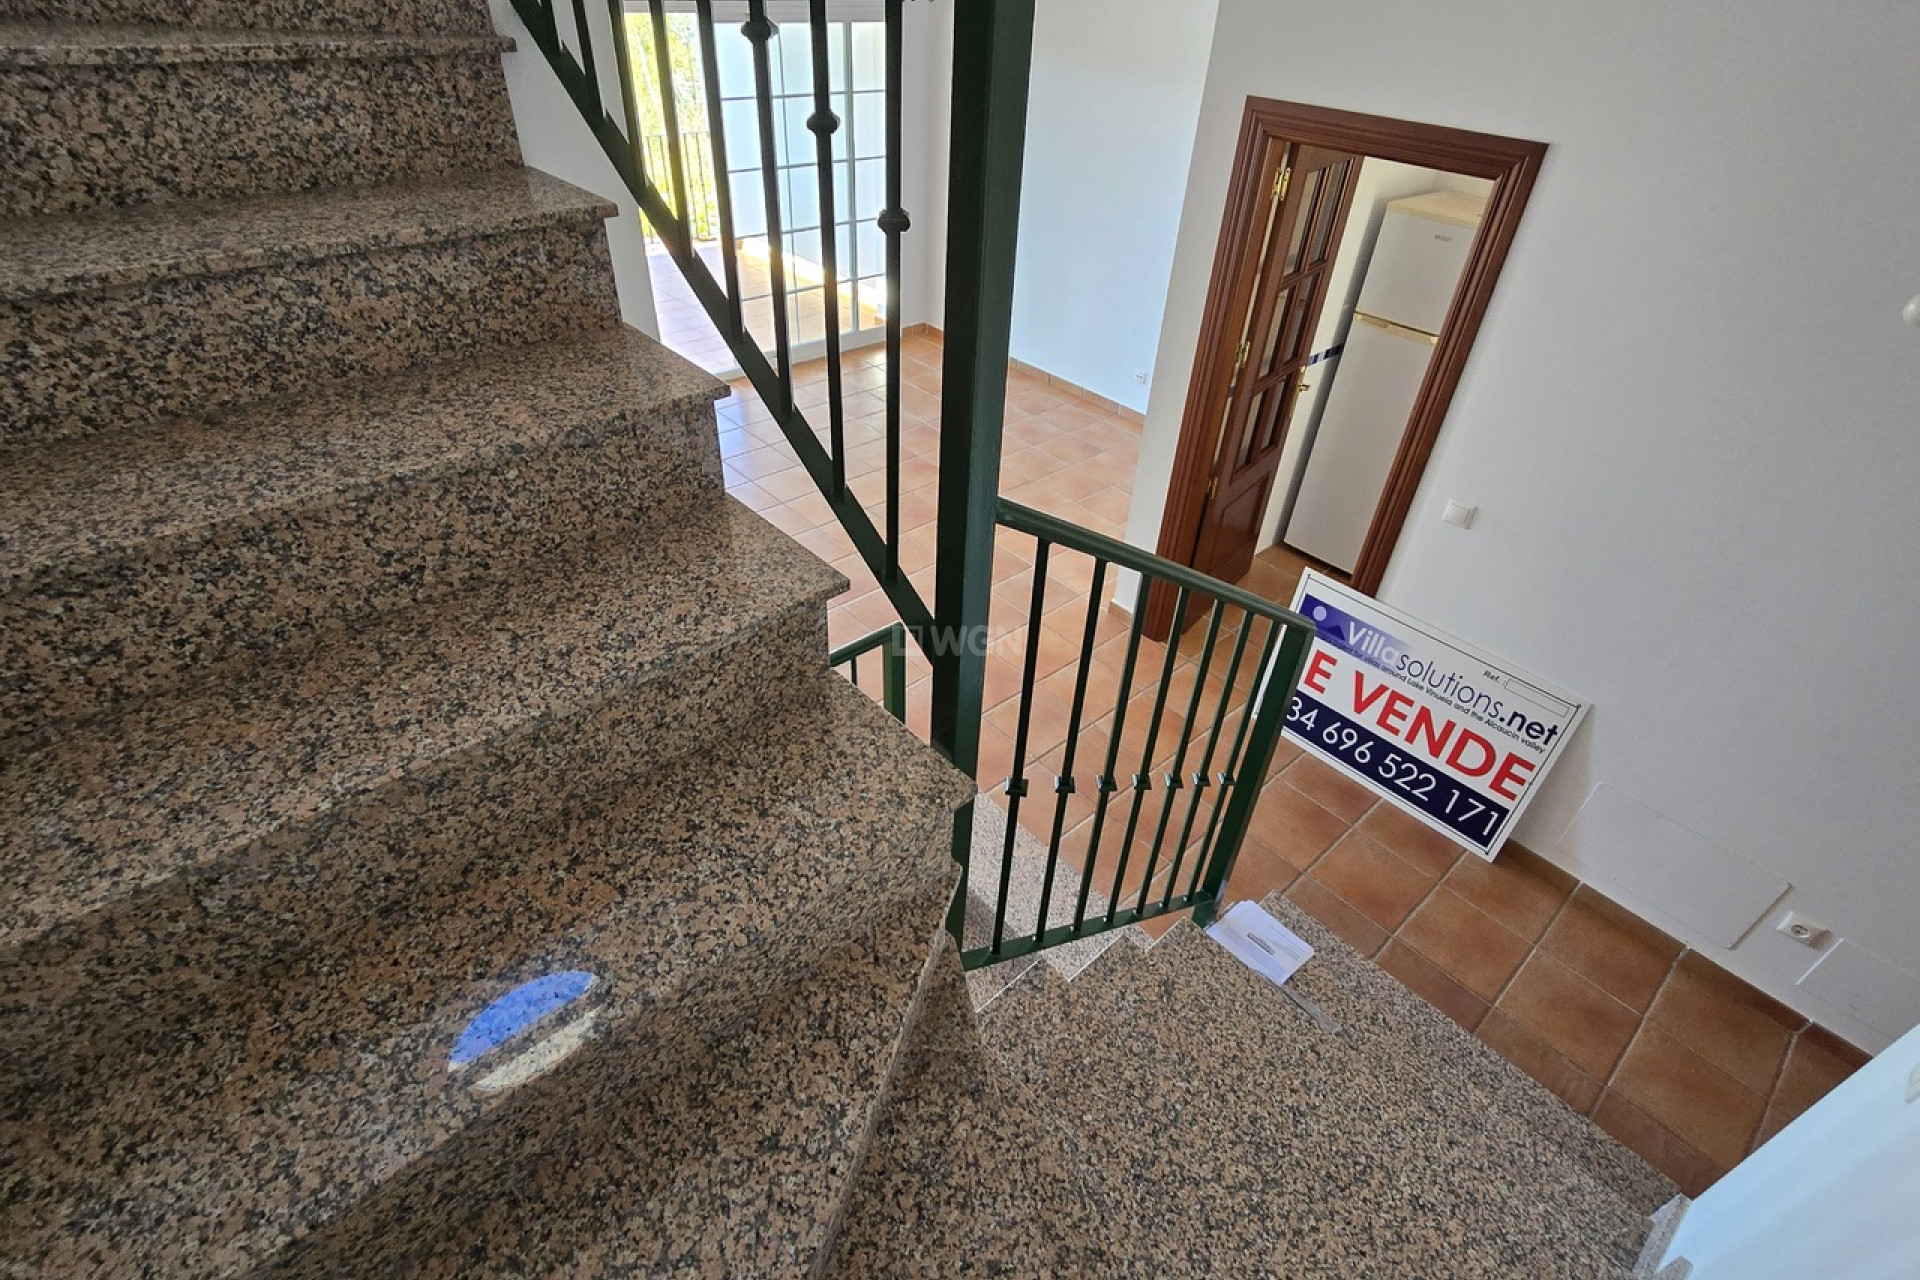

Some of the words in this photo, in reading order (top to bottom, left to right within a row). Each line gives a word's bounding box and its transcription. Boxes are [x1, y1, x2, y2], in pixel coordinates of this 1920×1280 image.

[1304, 649, 1338, 695] E
[1353, 669, 1536, 801] VENDE
[1349, 621, 1558, 745] Villasolutions.net
[1381, 665, 1407, 681] around
[1407, 679, 1425, 691] Lake
[1453, 701, 1471, 715] and
[1470, 711, 1484, 722] the
[1521, 738, 1546, 755] valley
[1322, 722, 1375, 764] 696
[1378, 753, 1437, 802] 522
[1445, 789, 1499, 836] 171
